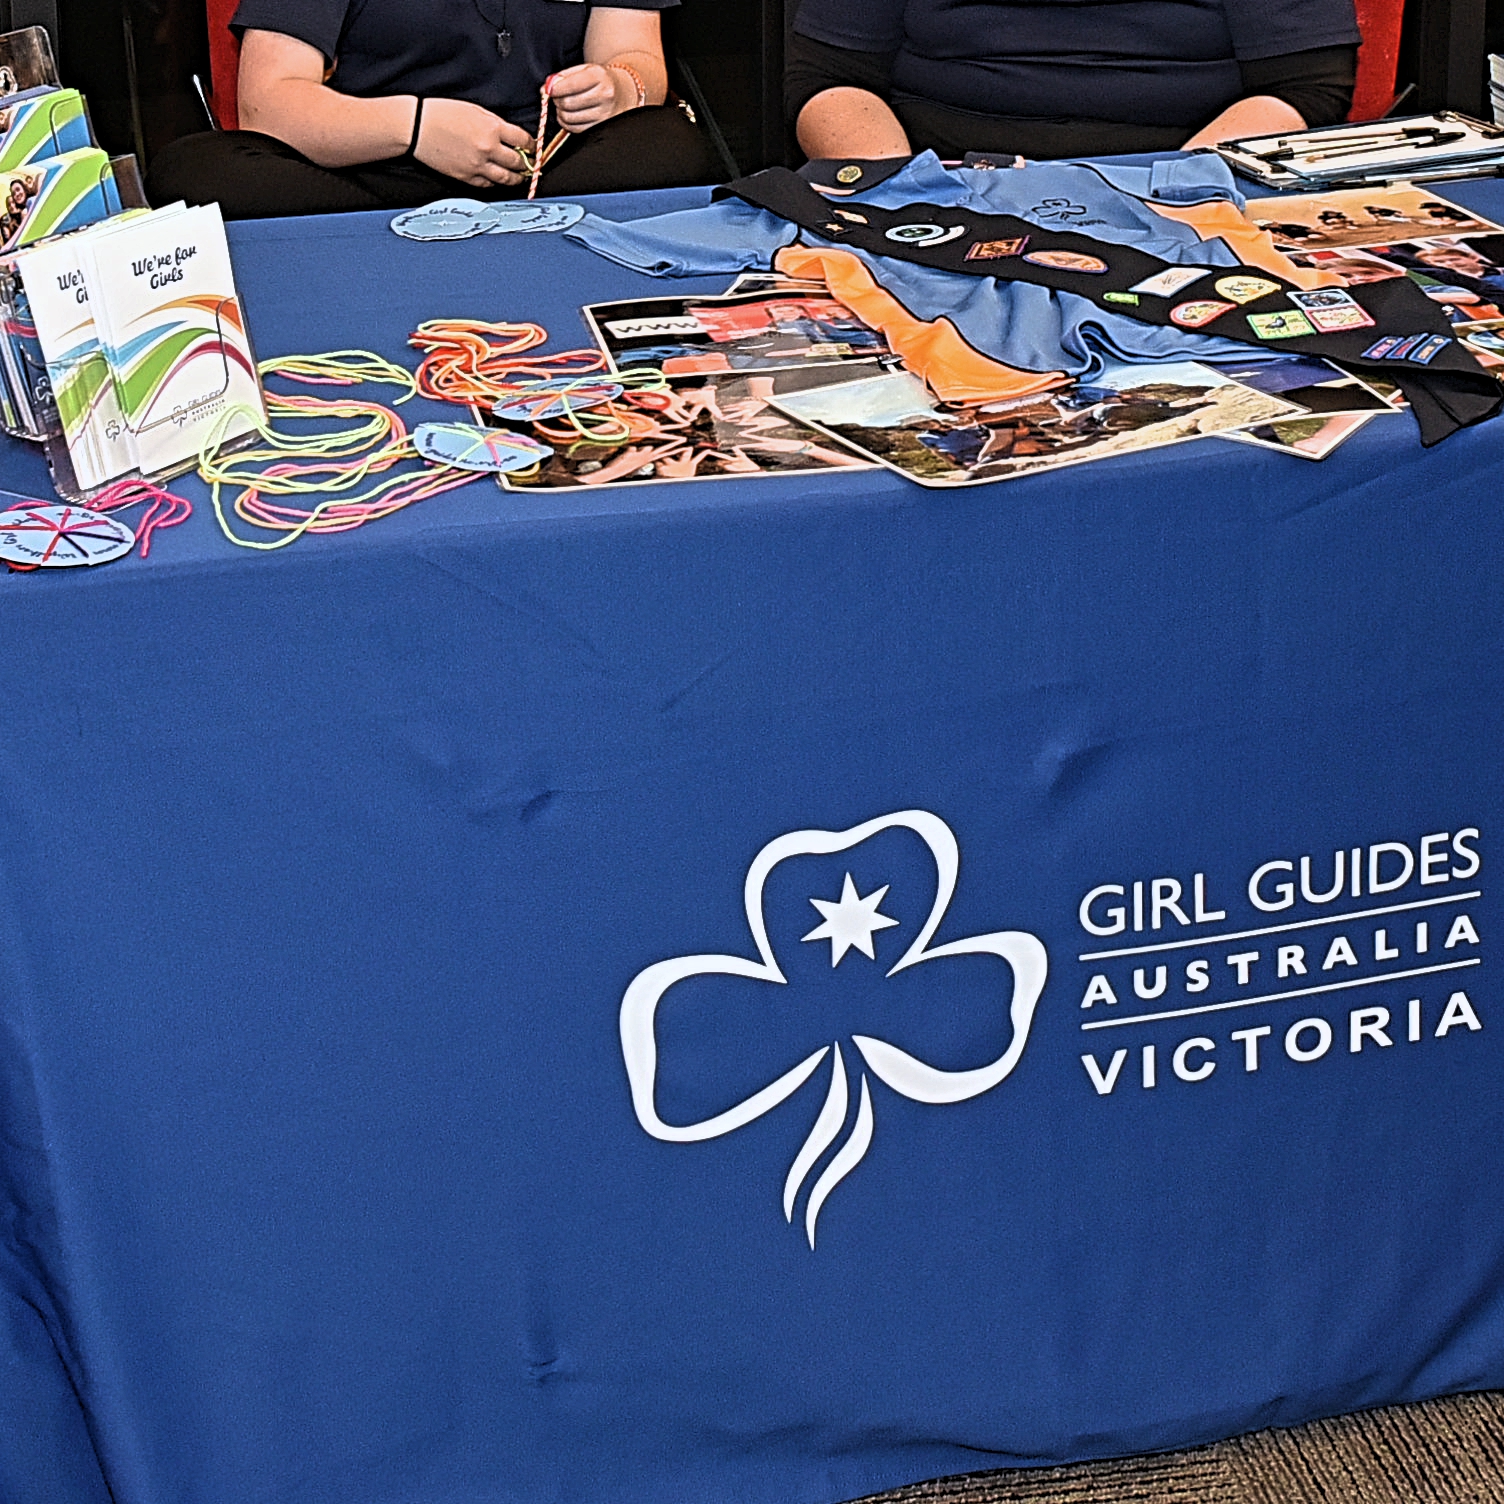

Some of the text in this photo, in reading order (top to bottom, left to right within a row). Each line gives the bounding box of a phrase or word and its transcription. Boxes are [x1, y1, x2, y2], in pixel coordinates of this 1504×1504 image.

[132, 245, 198, 277] We're for
[149, 266, 184, 290] Girls
[1078, 827, 1482, 936] GIRL GUIDES
[1080, 913, 1481, 1010] AUSTRALIA
[1080, 990, 1483, 1096] VICTORIA
